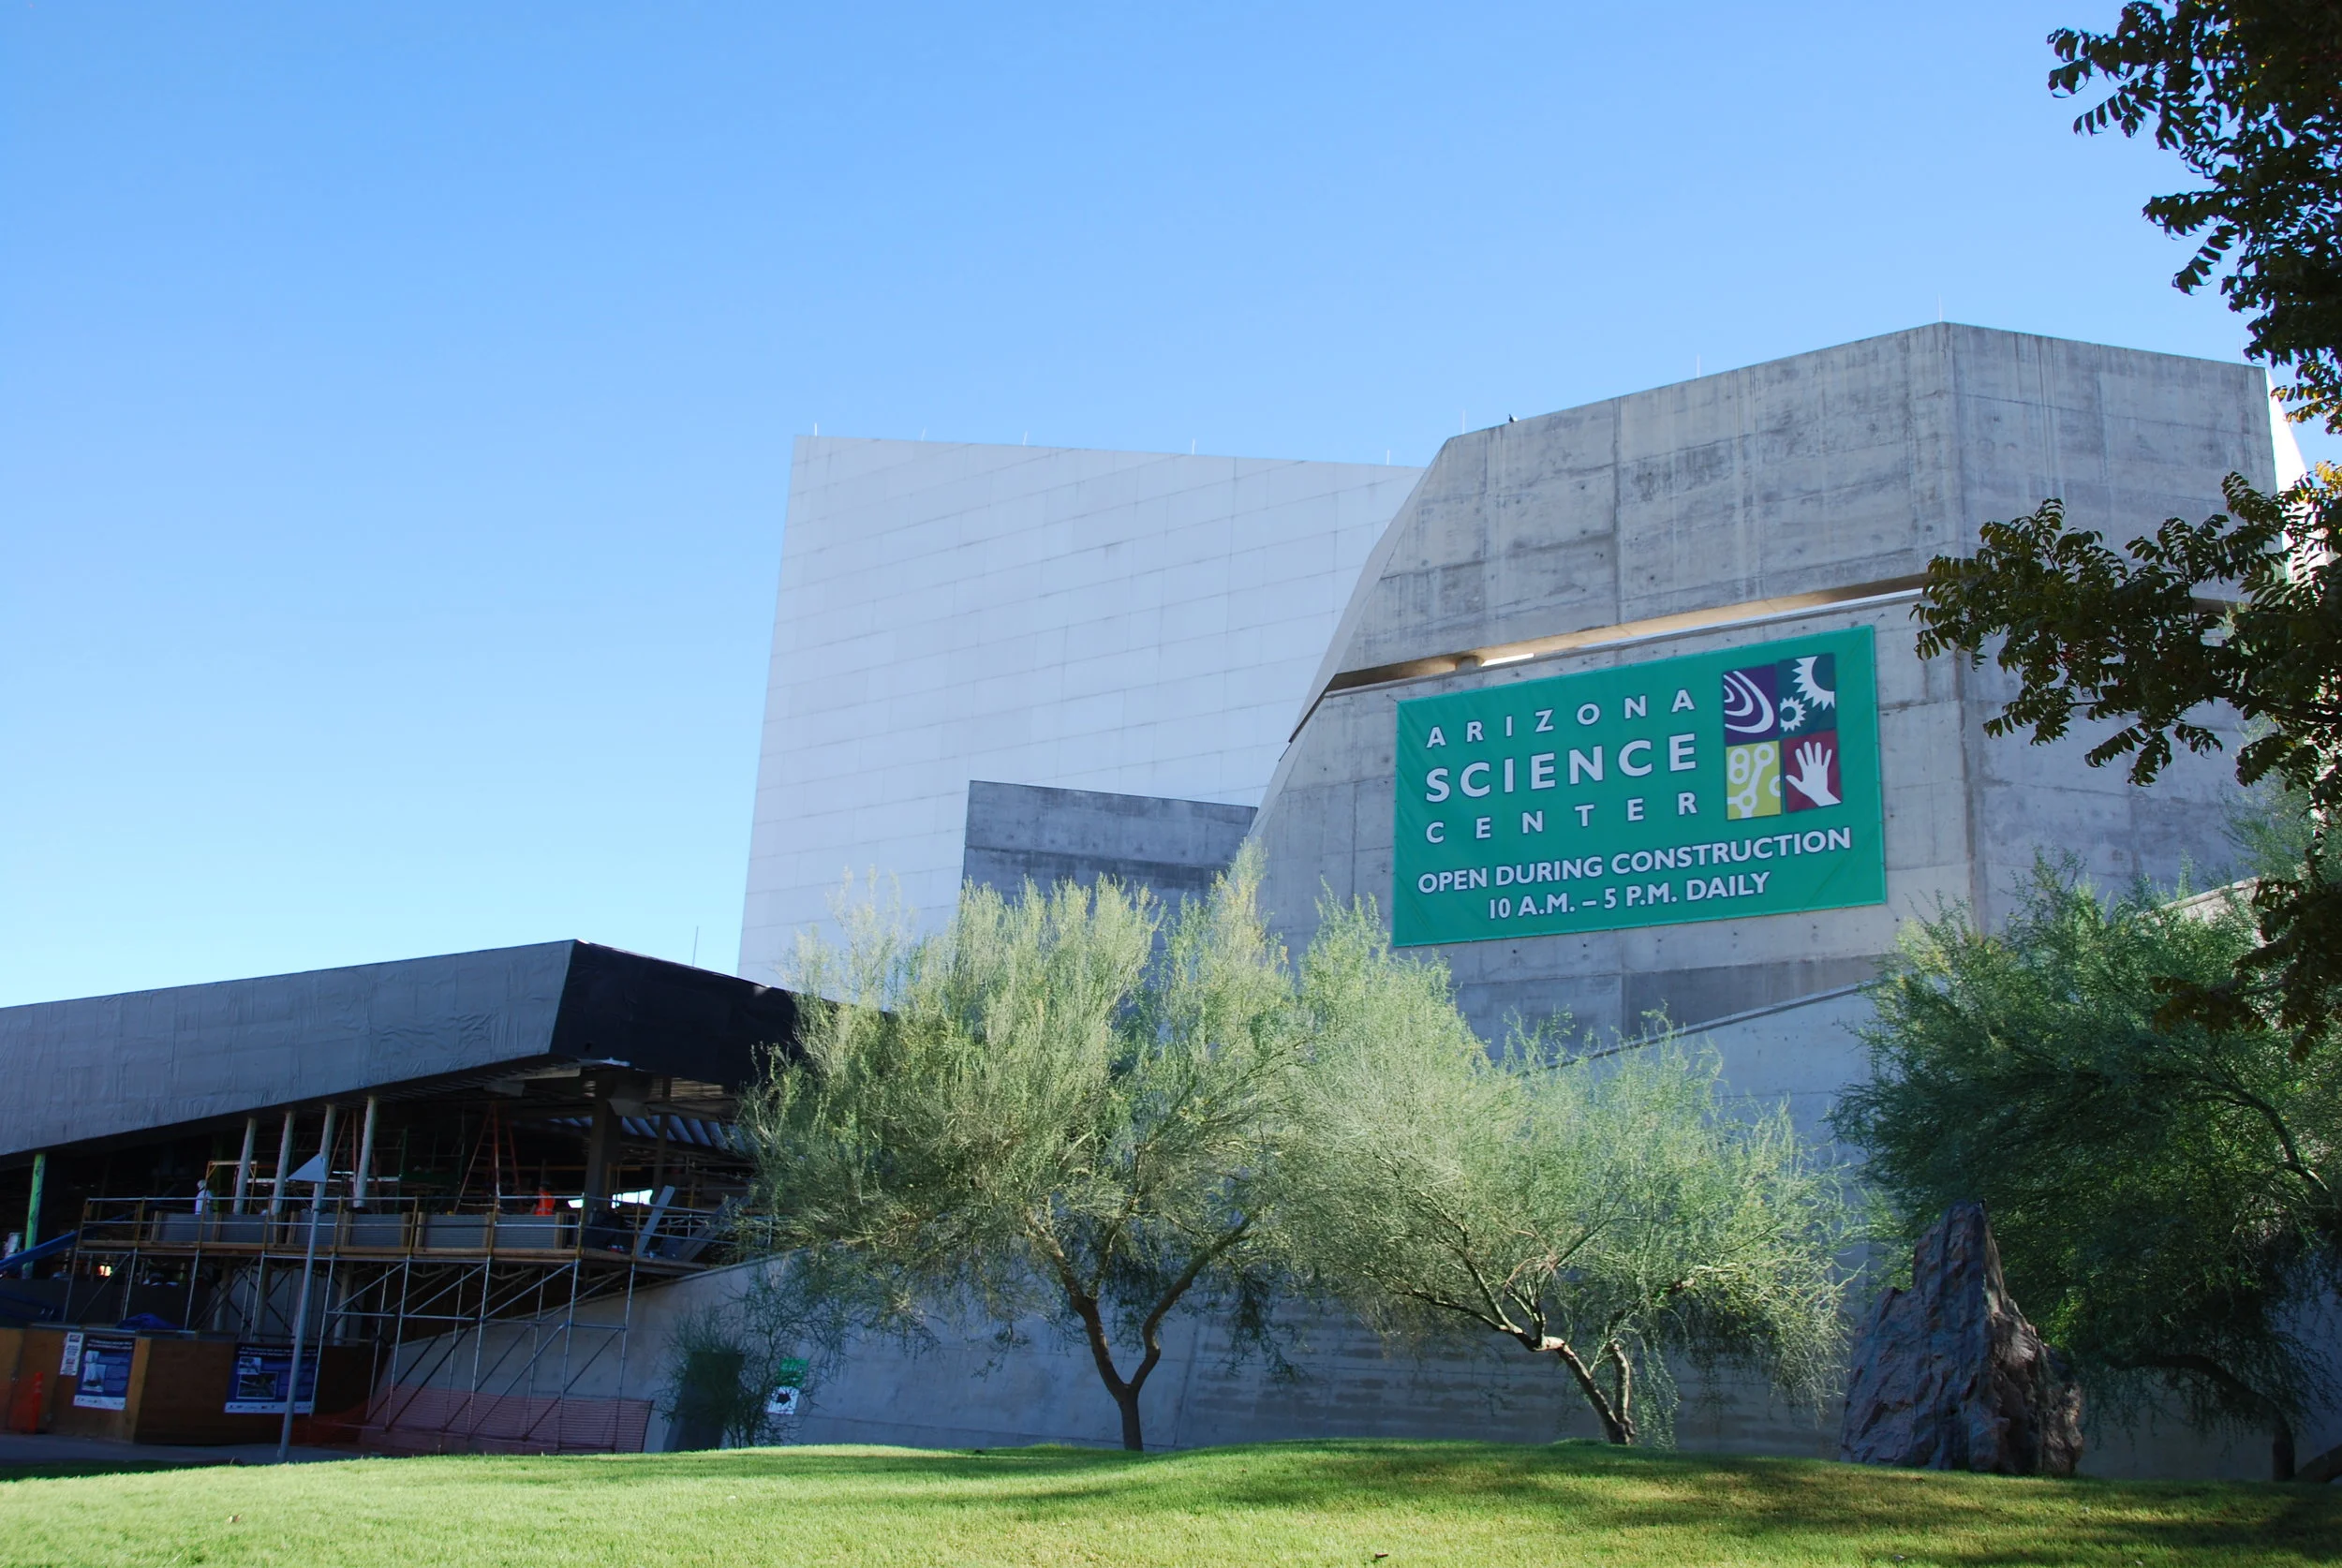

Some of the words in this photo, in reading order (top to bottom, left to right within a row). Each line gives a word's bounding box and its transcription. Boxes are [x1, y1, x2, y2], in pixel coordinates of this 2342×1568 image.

[1426, 687, 1697, 749] ARIZONA
[1425, 732, 1697, 804] SCIENCE
[1425, 791, 1698, 845] CENTER
[1417, 866, 1489, 895] OPEN
[1496, 855, 1604, 887] DURING
[1610, 826, 1852, 875] CONSTRUCTION
[1490, 896, 1511, 920] 10
[1517, 893, 1576, 917] A.M.
[1604, 887, 1618, 910] 5
[1625, 881, 1678, 908] P.M.
[1685, 870, 1771, 903] DAILY
